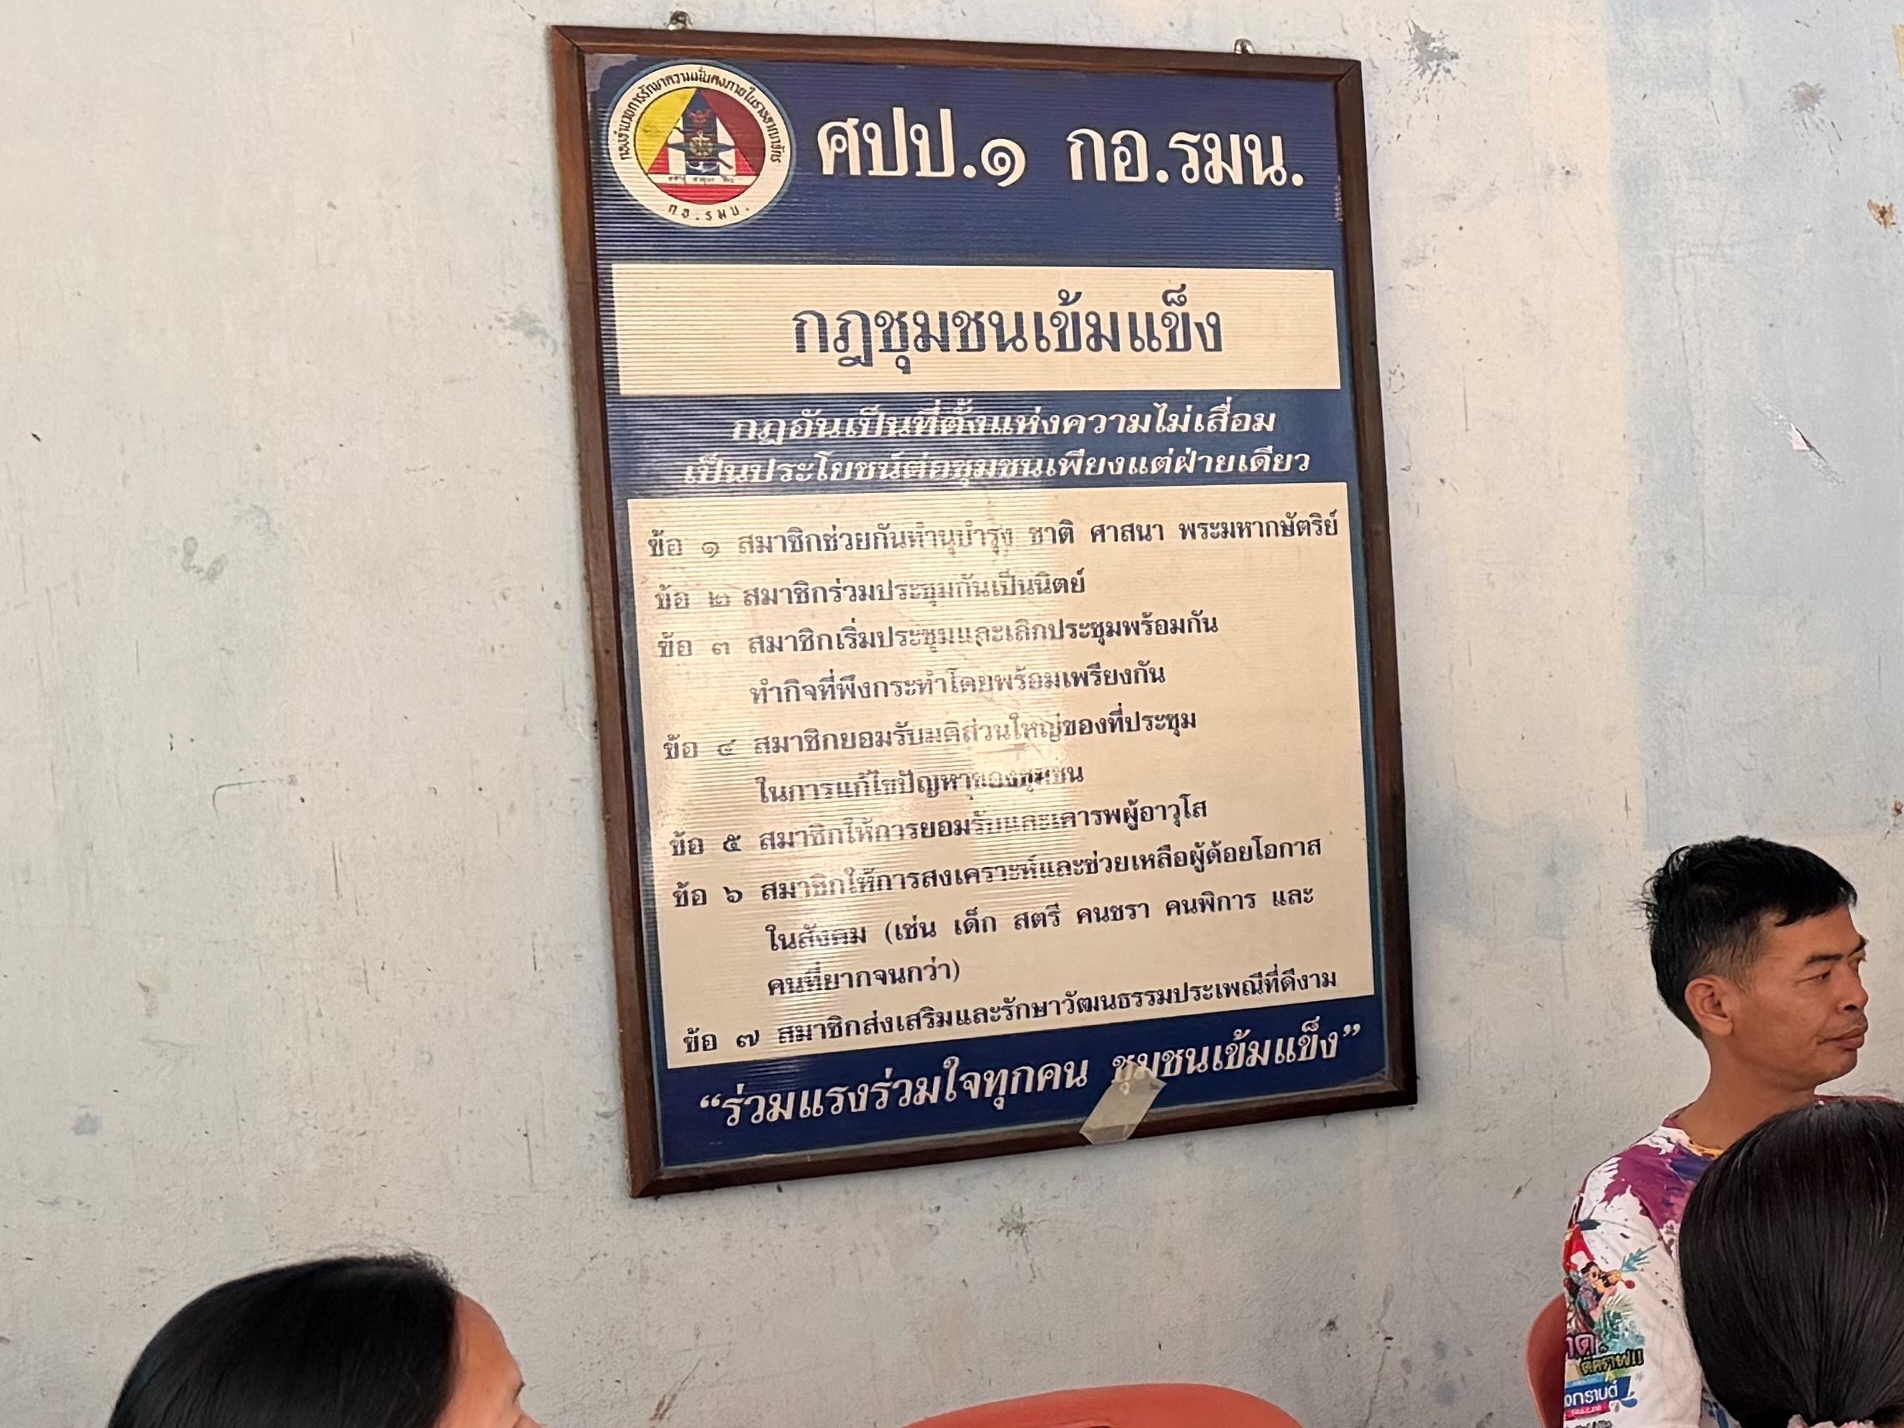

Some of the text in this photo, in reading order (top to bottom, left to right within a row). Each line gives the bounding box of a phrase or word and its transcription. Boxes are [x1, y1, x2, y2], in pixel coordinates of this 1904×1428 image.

[817, 106, 1305, 189] ศปป.๑ กอ.รมน.
[791, 282, 1224, 375] กฎชุมชนเข้มแข็ง
[648, 528, 684, 558] ข้อ
[700, 539, 721, 559] ๑
[1028, 518, 1076, 546] ชาติ
[1089, 520, 1166, 544] ศาสนา
[1178, 508, 1340, 541] พระมหากษัตริย์
[654, 583, 691, 611] ข้อ
[743, 567, 1087, 608] สมาชิกร่วมประชุมกันเป็นนิตย์
[657, 631, 694, 659] ข้อ
[748, 608, 1220, 656] สมาชิกเริ่มประชุมและเลิกประชุมพร้อมกัน
[750, 658, 1167, 705] ทำกิจที่พึงกระทำโดยพร้อมเพรียงกัน
[663, 733, 699, 760] ข้อ
[669, 830, 706, 857] ข้อ
[759, 793, 1209, 852] สมาชิกให้การยอมรับและเคารพผู้อาวุโส
[672, 835, 1323, 908] ข้อ ๖ สมาชิกให้การสงเคราะห์และช่วยเหลือผู้ด้อยโอกาส
[764, 885, 1315, 953] ในสังคม (เช่น เด็ก สตรี คนชรา คนพิการ และ
[767, 956, 962, 998] คนที่ยากจนกว่า)
[682, 962, 1338, 1054] ข้อ ๗ สมาชิกส่งเสริมและรักษาวัฒนธรรมประเพณีที่ดีงาม
